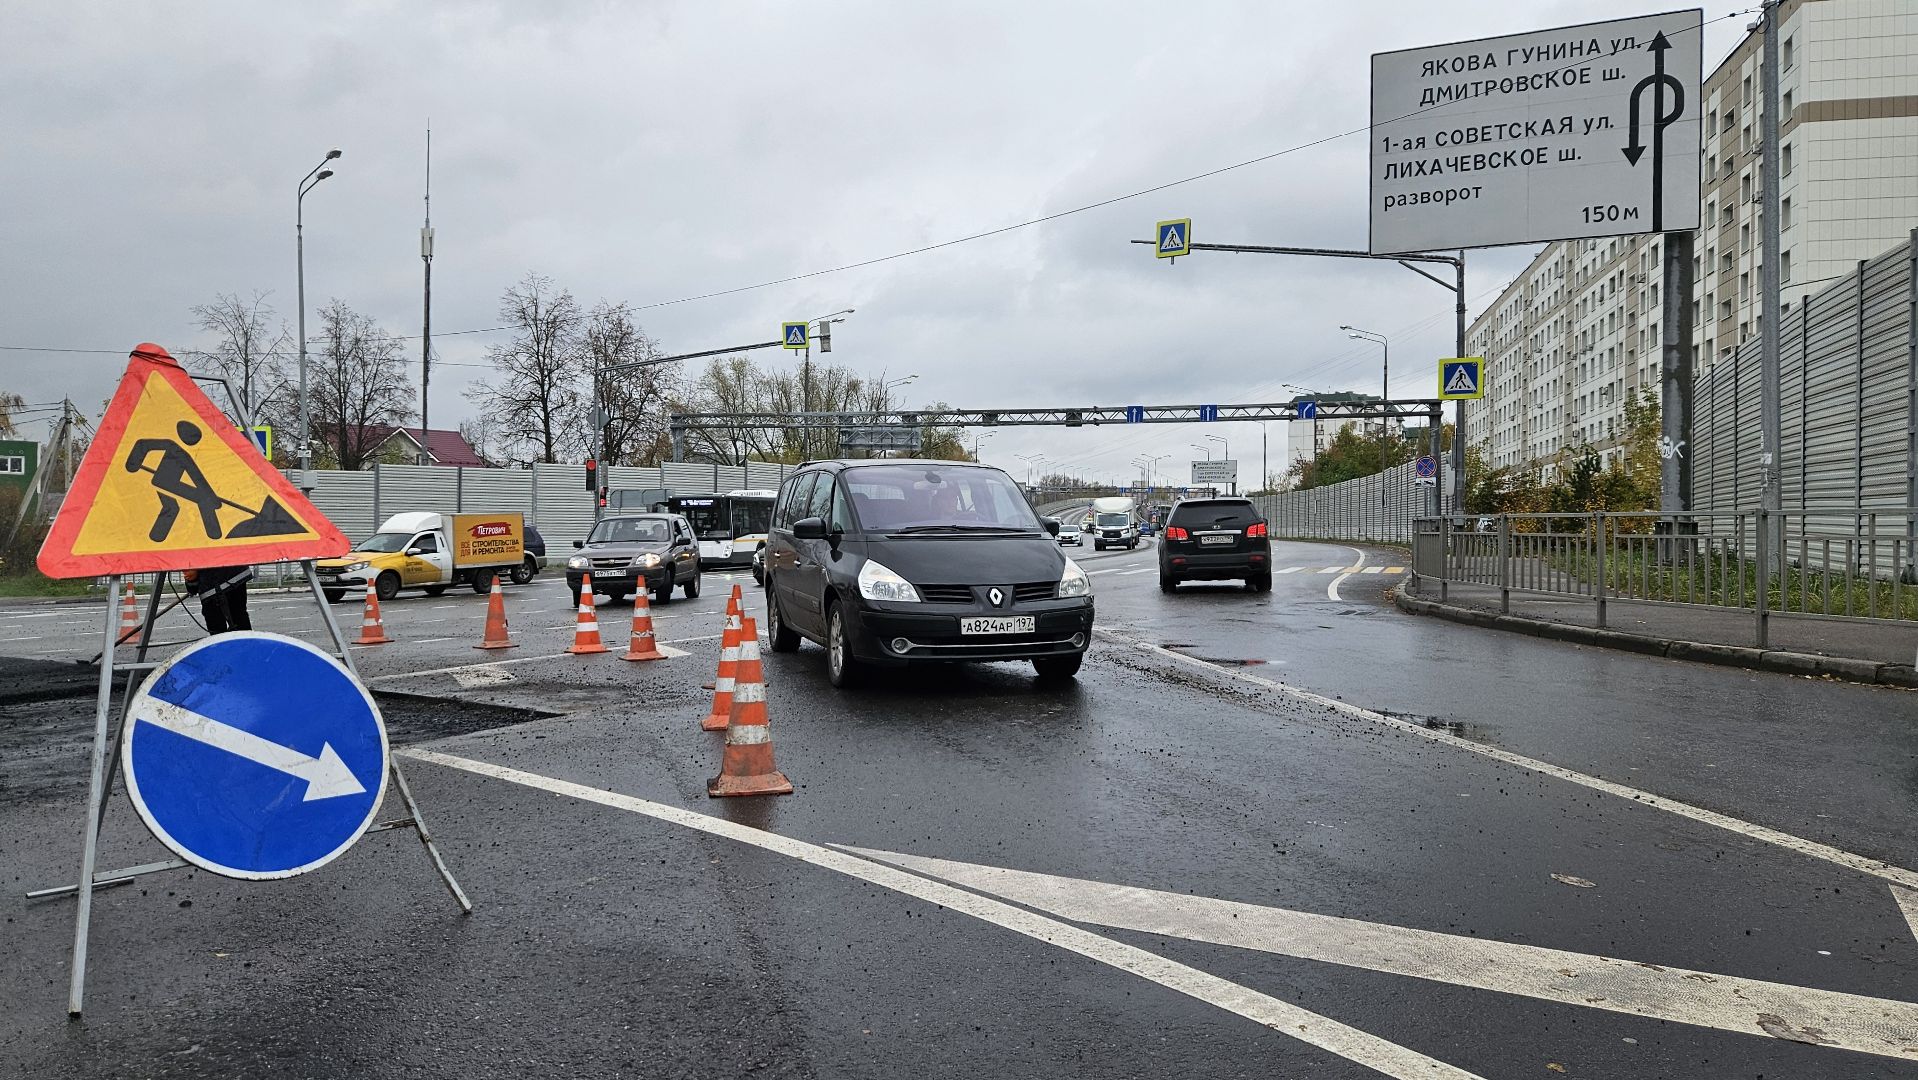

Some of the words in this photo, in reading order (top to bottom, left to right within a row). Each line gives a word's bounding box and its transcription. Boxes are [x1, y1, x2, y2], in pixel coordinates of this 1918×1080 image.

[1420, 52, 1497, 78] ЯКОВА
[1507, 38, 1601, 66] ГУНИНА
[1610, 36, 1641, 56] ул.
[1419, 67, 1591, 107] ДМИТРОВСКОЕ
[1602, 67, 1626, 82] ш.
[1382, 136, 1426, 153] 1-ая
[1435, 115, 1573, 147] СОВЕТСКАЯ
[1583, 116, 1614, 136] ул.
[1383, 146, 1548, 180] ЛИХАЧЕВСКОЕ
[1558, 148, 1582, 162] ш.
[1384, 186, 1483, 212] разворот
[477, 525, 506, 535] ПЕТРОВИЧ
[472, 539, 519, 548] СТРОИТЕЛЬСТВА
[478, 547, 505, 555] РЕМОНТА
[966, 619, 1013, 633] А824АР
[1016, 617, 1032, 628] 197
